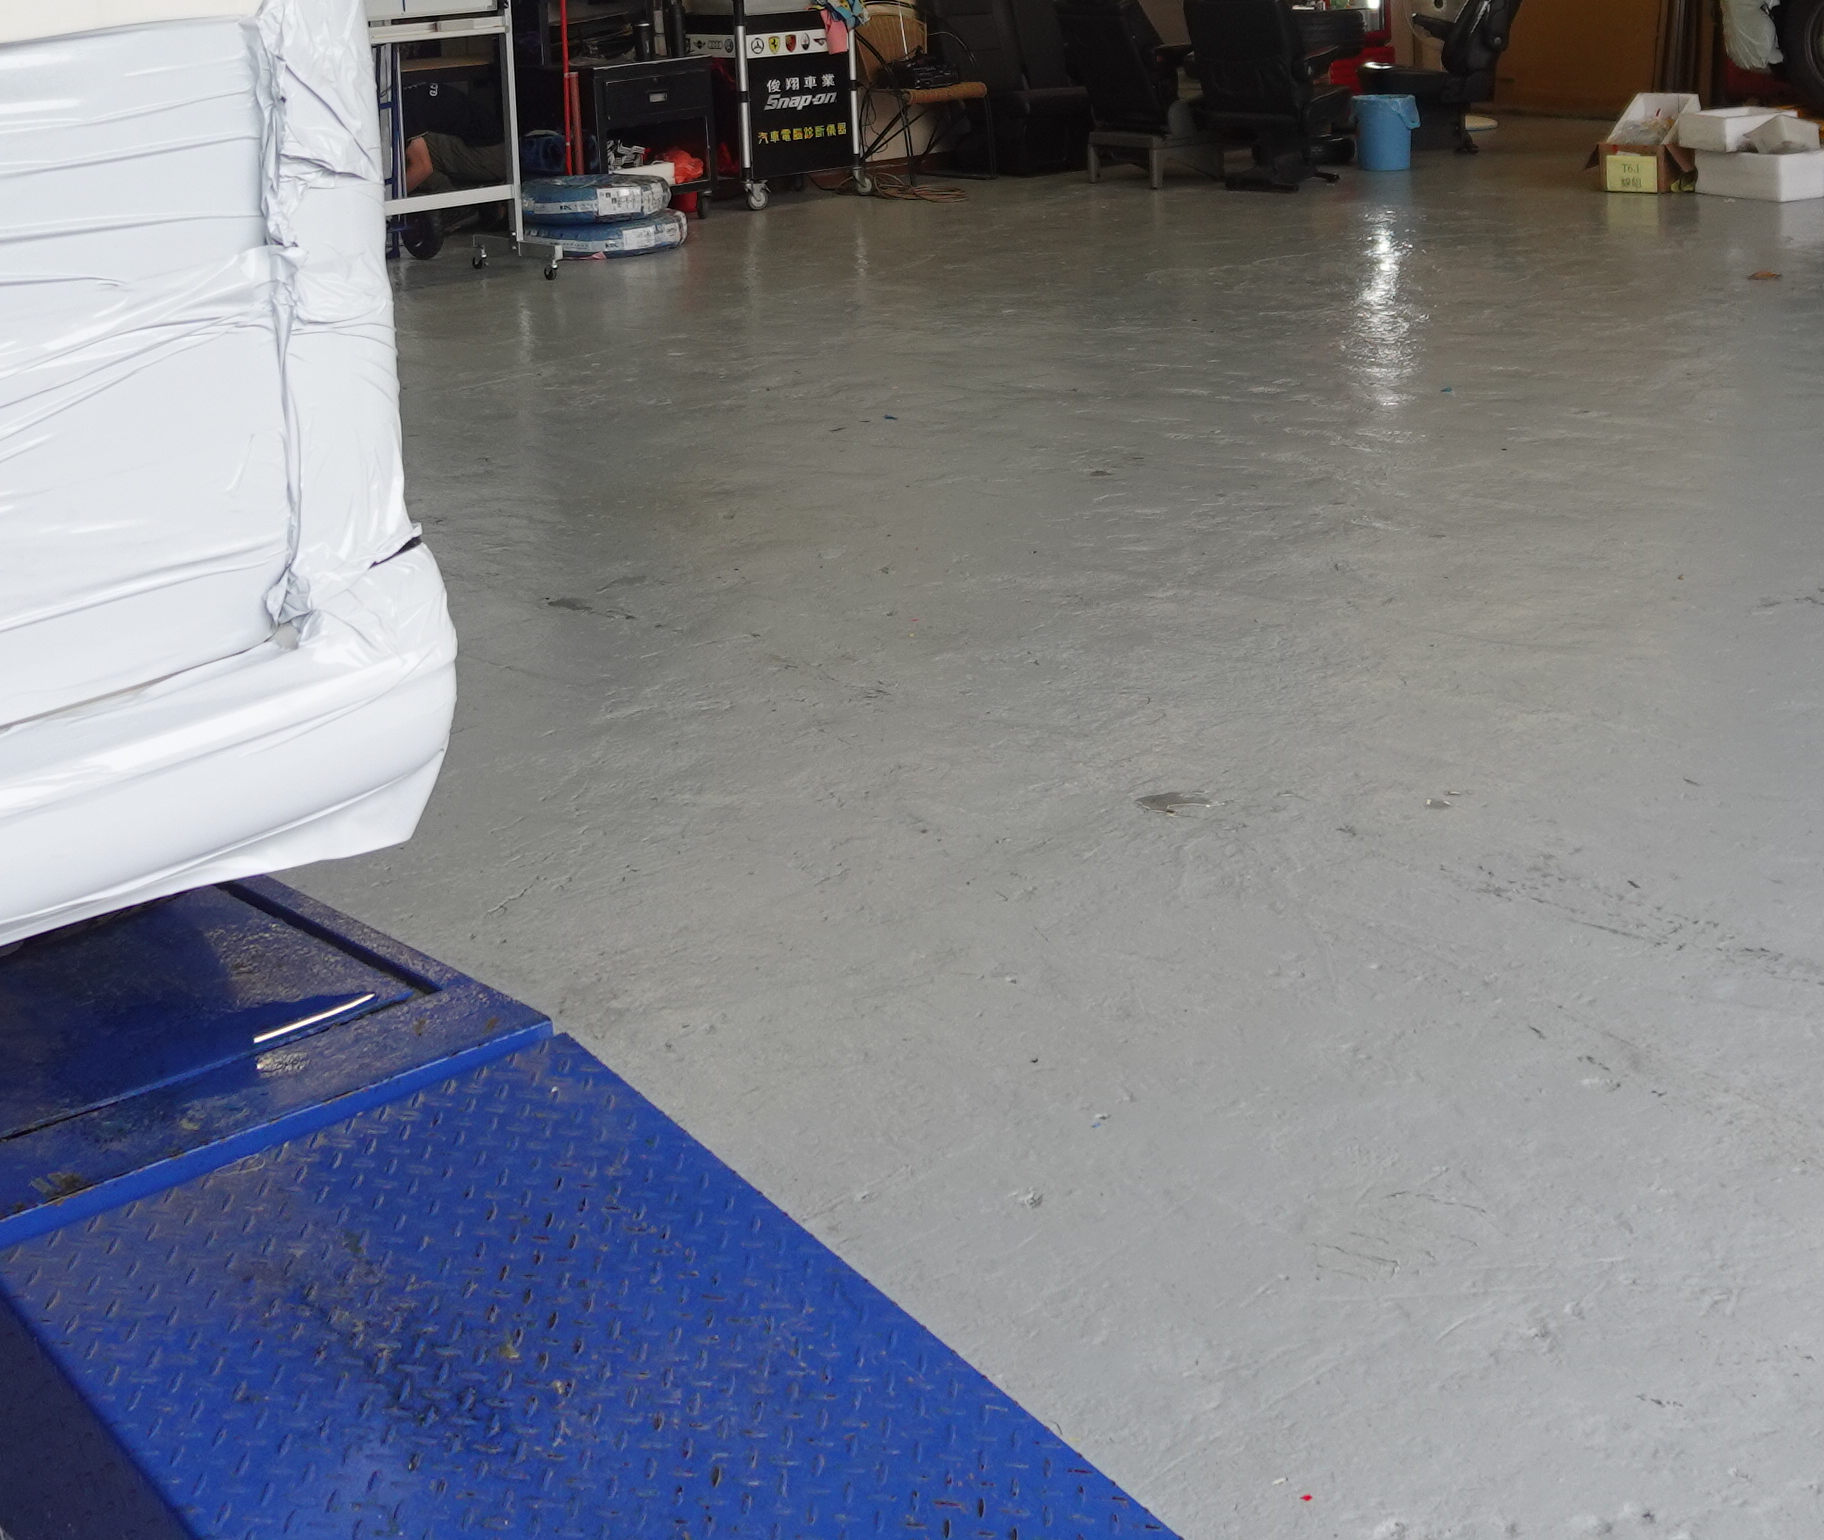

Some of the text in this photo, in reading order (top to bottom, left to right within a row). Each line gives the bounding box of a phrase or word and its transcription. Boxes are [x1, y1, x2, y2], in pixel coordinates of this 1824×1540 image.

[766, 73, 836, 94] 俊翔車業
[764, 91, 838, 111] Snap-on
[757, 122, 847, 145] 汽車電腦診斷儀器
